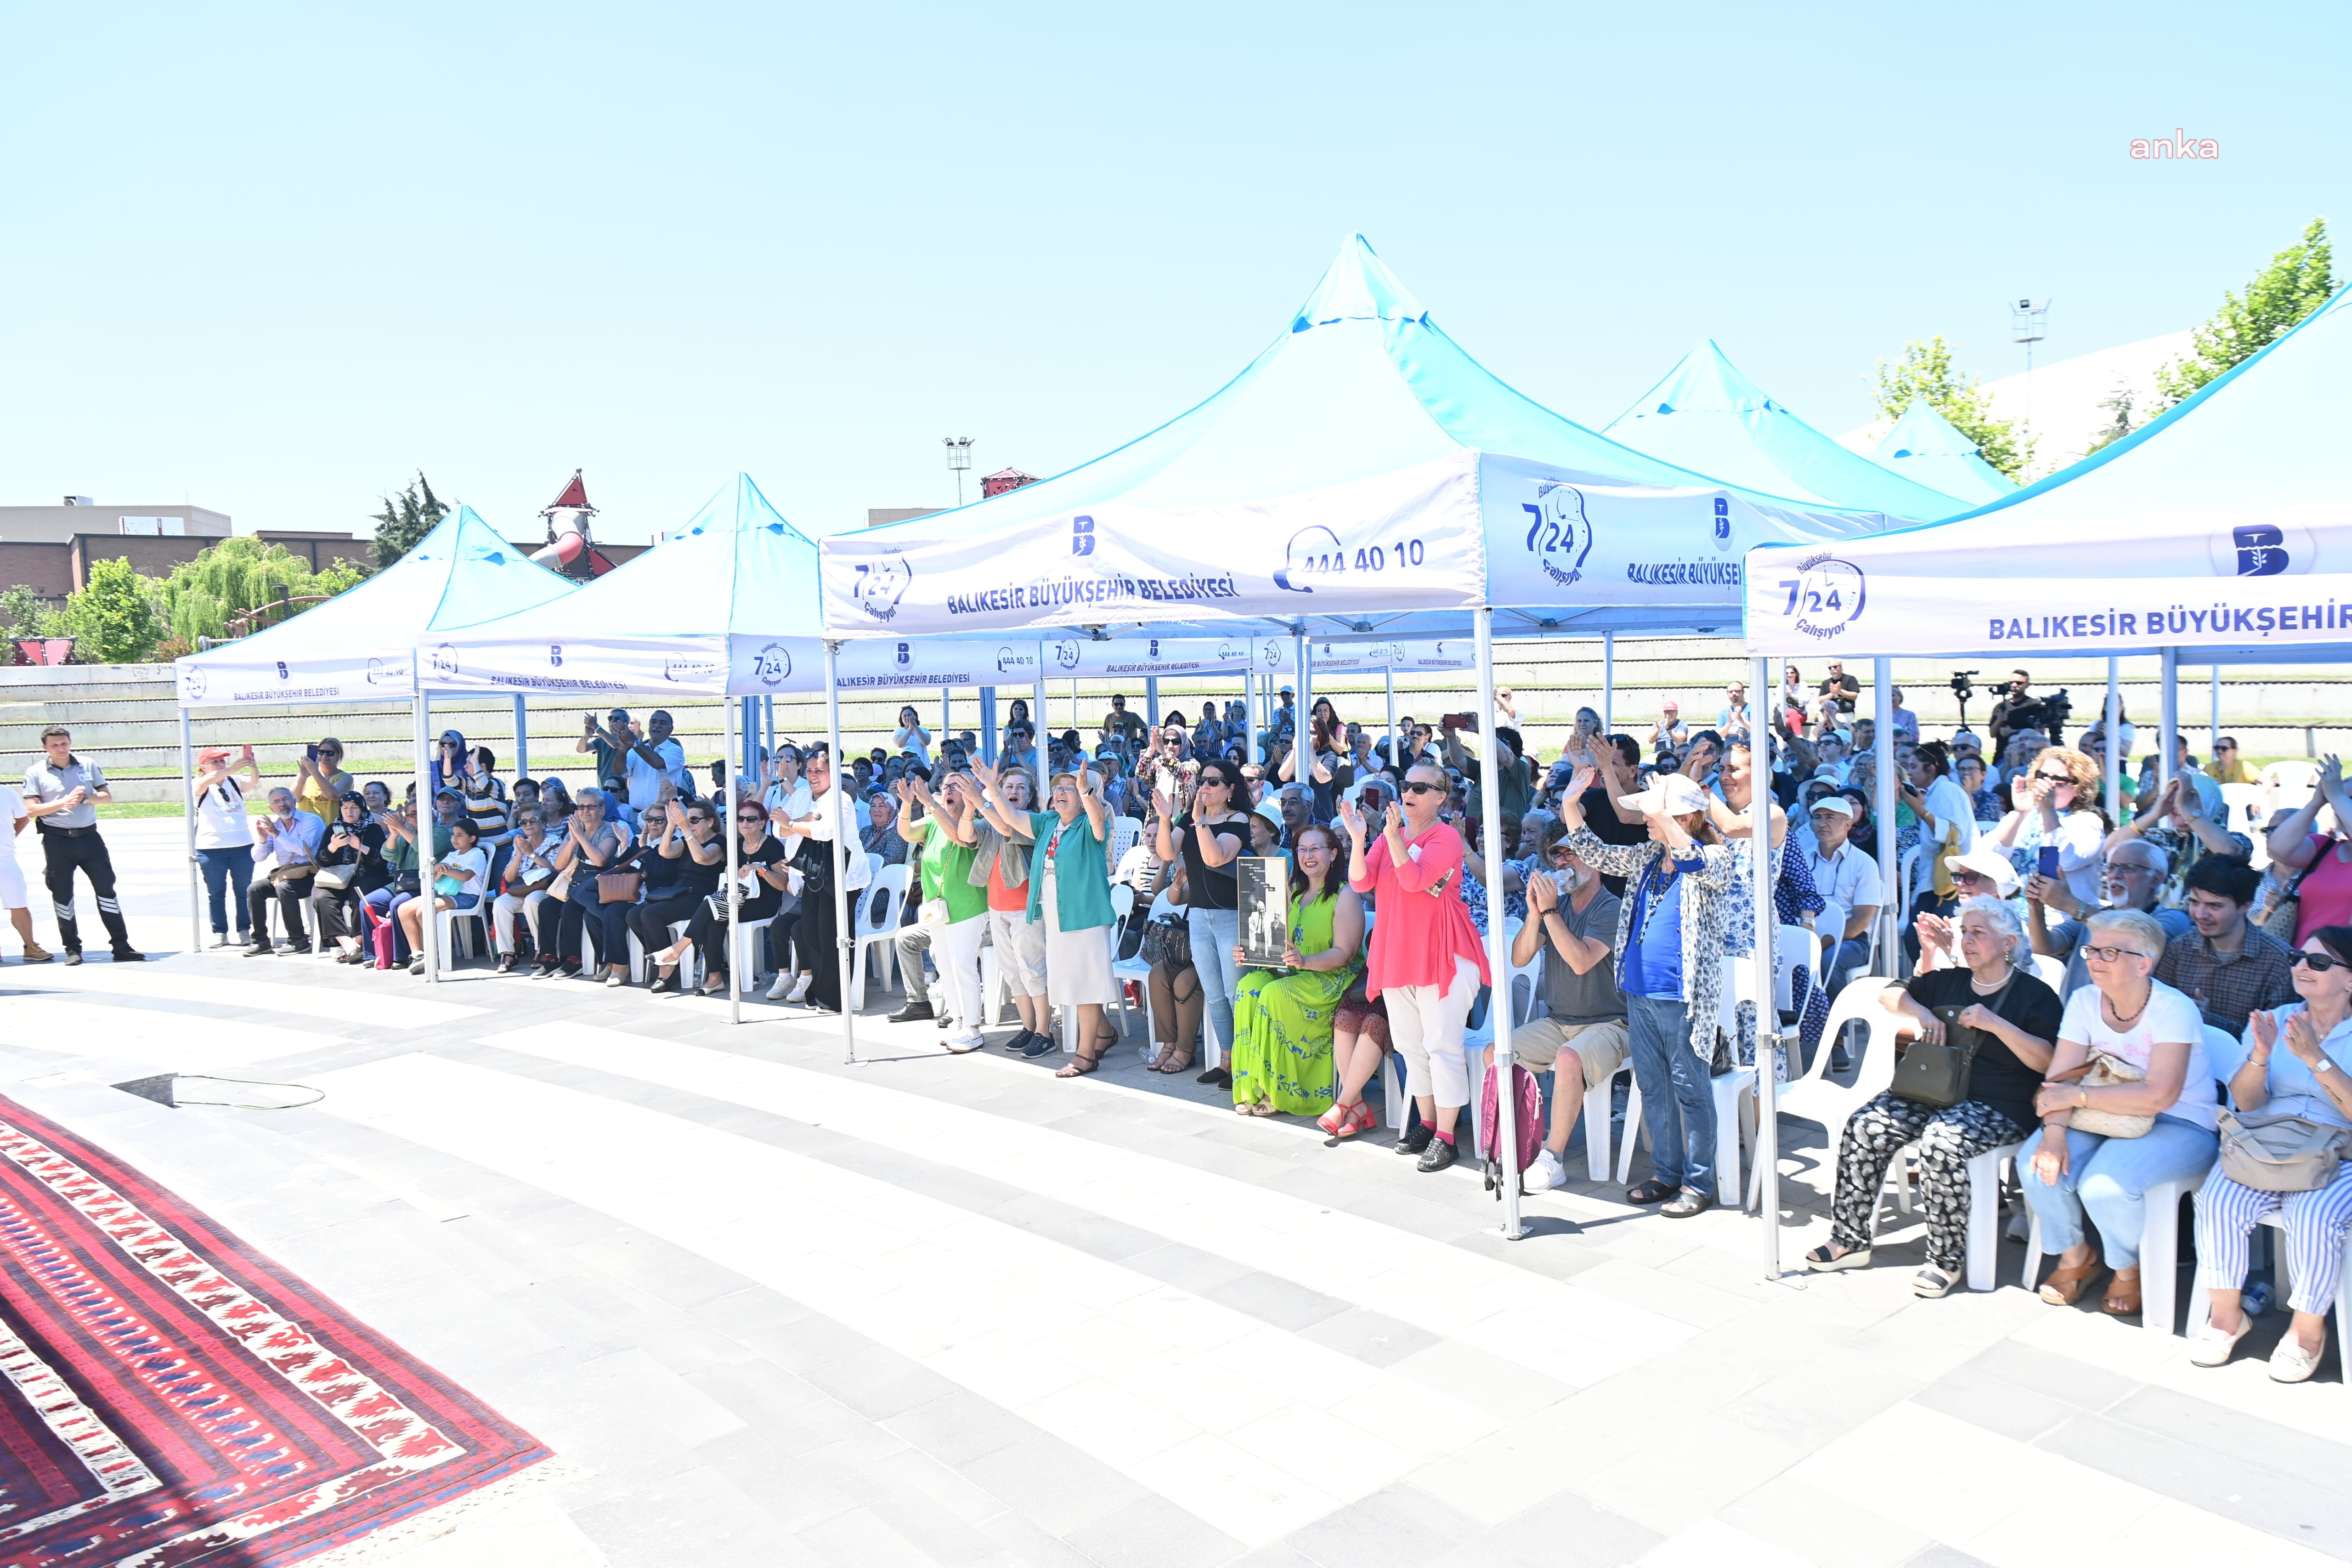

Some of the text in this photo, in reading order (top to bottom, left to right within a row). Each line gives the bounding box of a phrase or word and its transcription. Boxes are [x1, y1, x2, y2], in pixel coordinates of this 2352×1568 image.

[1299, 539, 1424, 574] 444 40 10
[1628, 557, 1690, 585] BALIKESİR
[947, 572, 1242, 614] BALIKESİR BÜYÜKŞEHİR BELEDİYESİ
[864, 601, 897, 623] Çalışıyor
[1794, 618, 1846, 641] Çalışıyor
[1990, 607, 2137, 640] BALIKESİR
[1003, 657, 1015, 665] 444
[1026, 657, 1033, 665] 10
[1106, 662, 1137, 672] BALIKESİR
[1136, 662, 1170, 673] BÜYÜKŞEHİR
[531, 676, 581, 690] BÜYÜKŞEHİR
[836, 672, 970, 687] ALIKESİR BÜYÜKŞEHİR BELEDİYESİ
[234, 685, 339, 701] BALIKESİR BÜYÜKŞEHİR BELEDİYESİ
